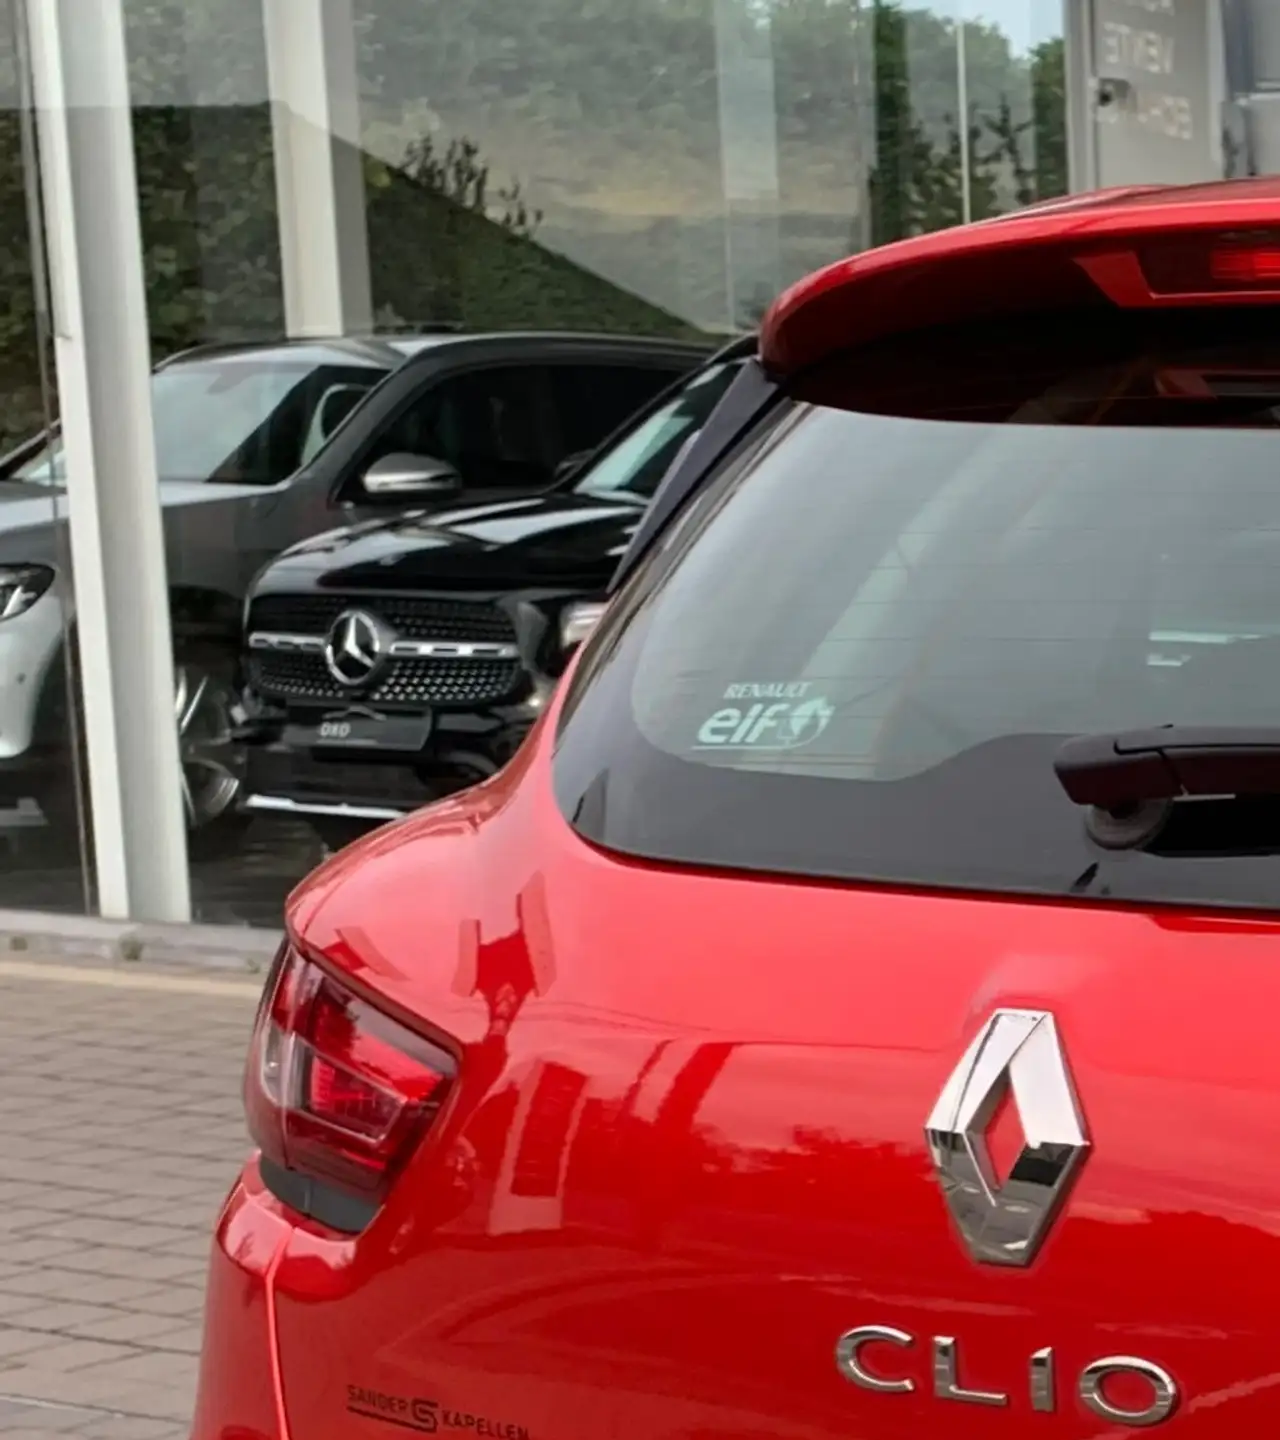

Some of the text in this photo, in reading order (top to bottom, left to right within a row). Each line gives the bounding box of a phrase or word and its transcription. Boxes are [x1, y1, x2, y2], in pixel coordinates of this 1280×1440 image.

[723, 681, 813, 699] RENAULT
[697, 703, 791, 743] elf
[836, 1325, 1175, 1426] CLIO
[345, 1384, 408, 1414] SANDER
